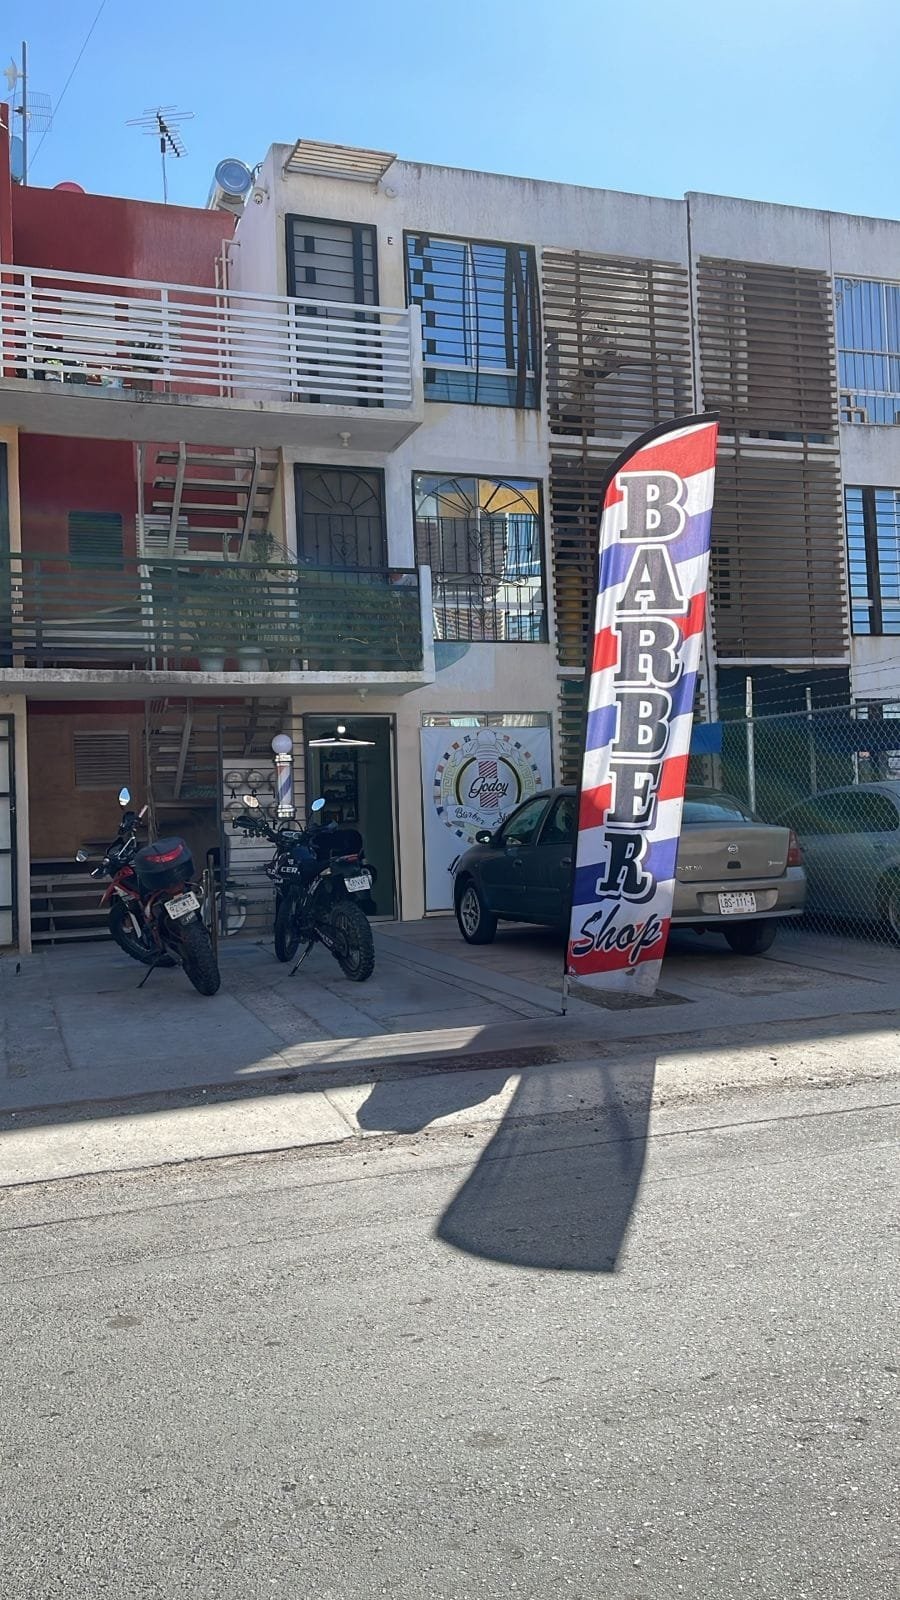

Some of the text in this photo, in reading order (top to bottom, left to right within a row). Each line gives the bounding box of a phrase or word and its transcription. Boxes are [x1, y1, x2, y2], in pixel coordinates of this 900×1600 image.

[387, 236, 393, 246] E
[596, 470, 688, 904] BARBER
[468, 776, 509, 799] Godoy
[455, 807, 485, 825] Barber
[571, 903, 662, 964] Shop
